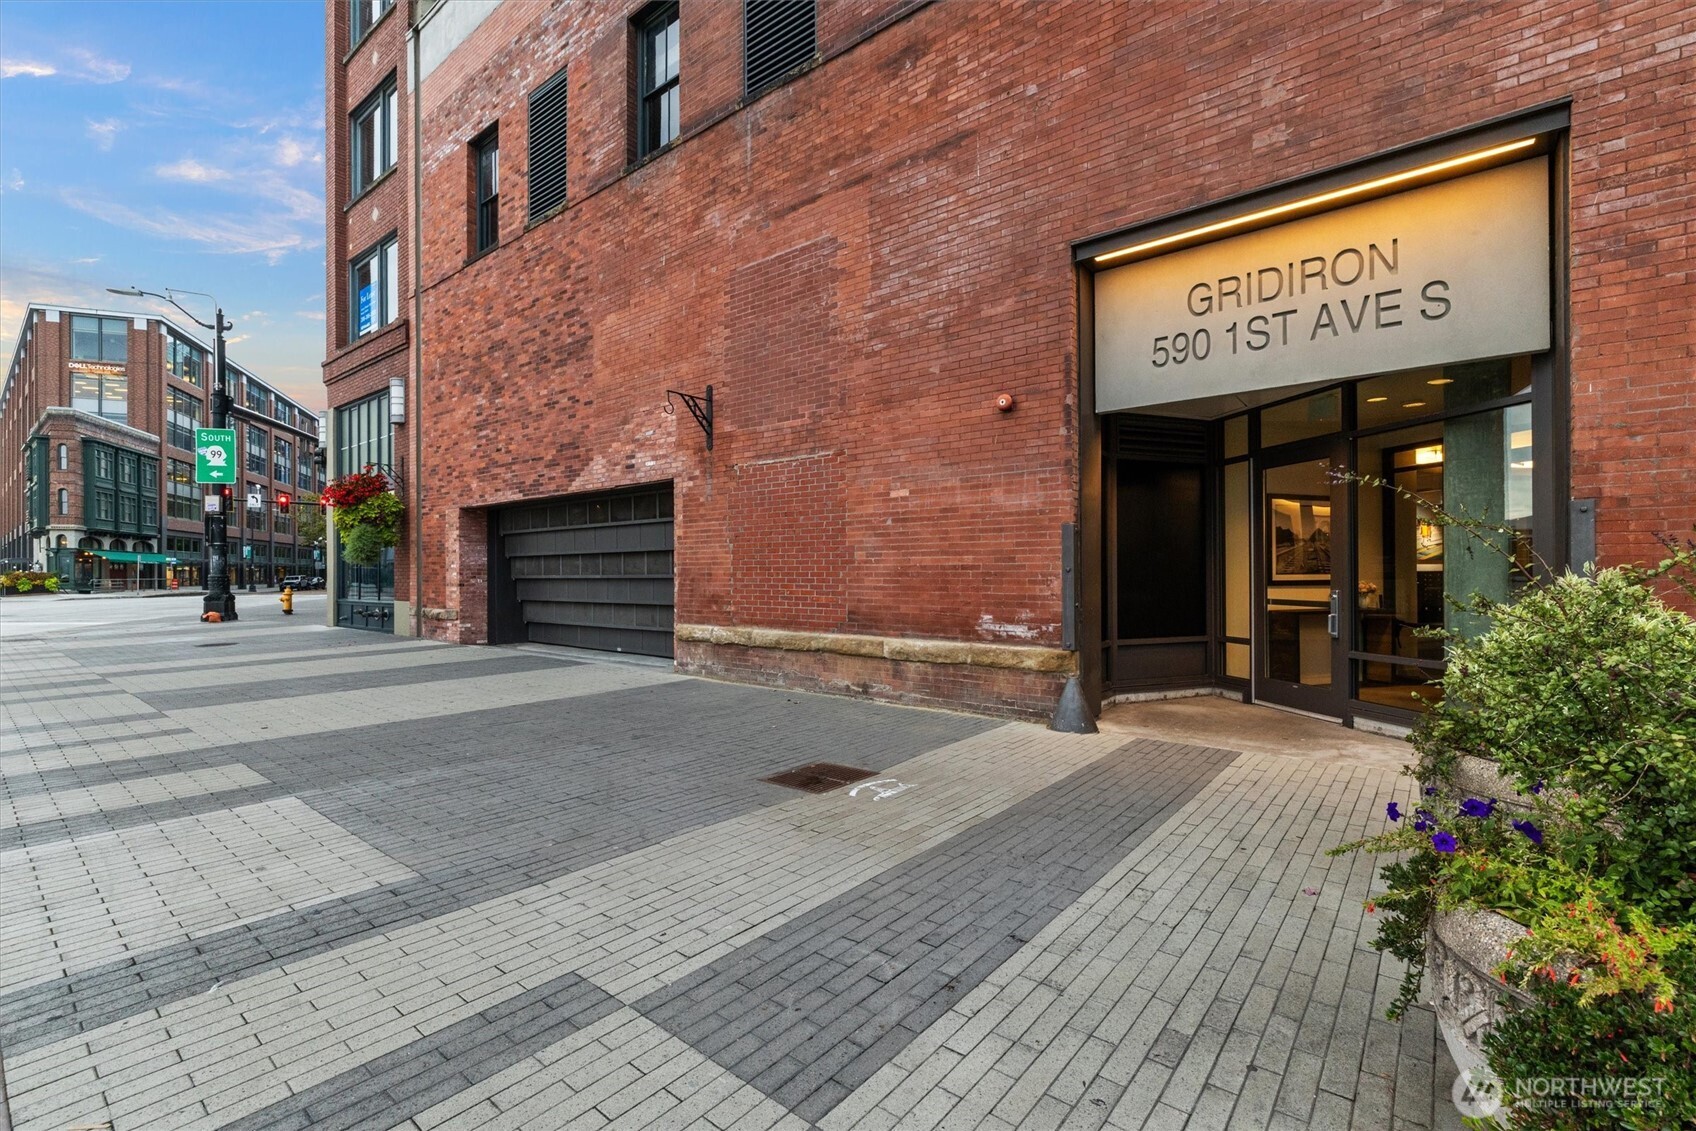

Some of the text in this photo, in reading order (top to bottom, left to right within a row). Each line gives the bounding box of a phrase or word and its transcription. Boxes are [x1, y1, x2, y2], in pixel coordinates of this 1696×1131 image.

[1187, 238, 1399, 317] GRIDIRON
[1152, 280, 1452, 368] 590 1ST AVE S
[86, 364, 126, 372] Technologies
[201, 433, 231, 442] SOUTH
[210, 450, 223, 459] 99
